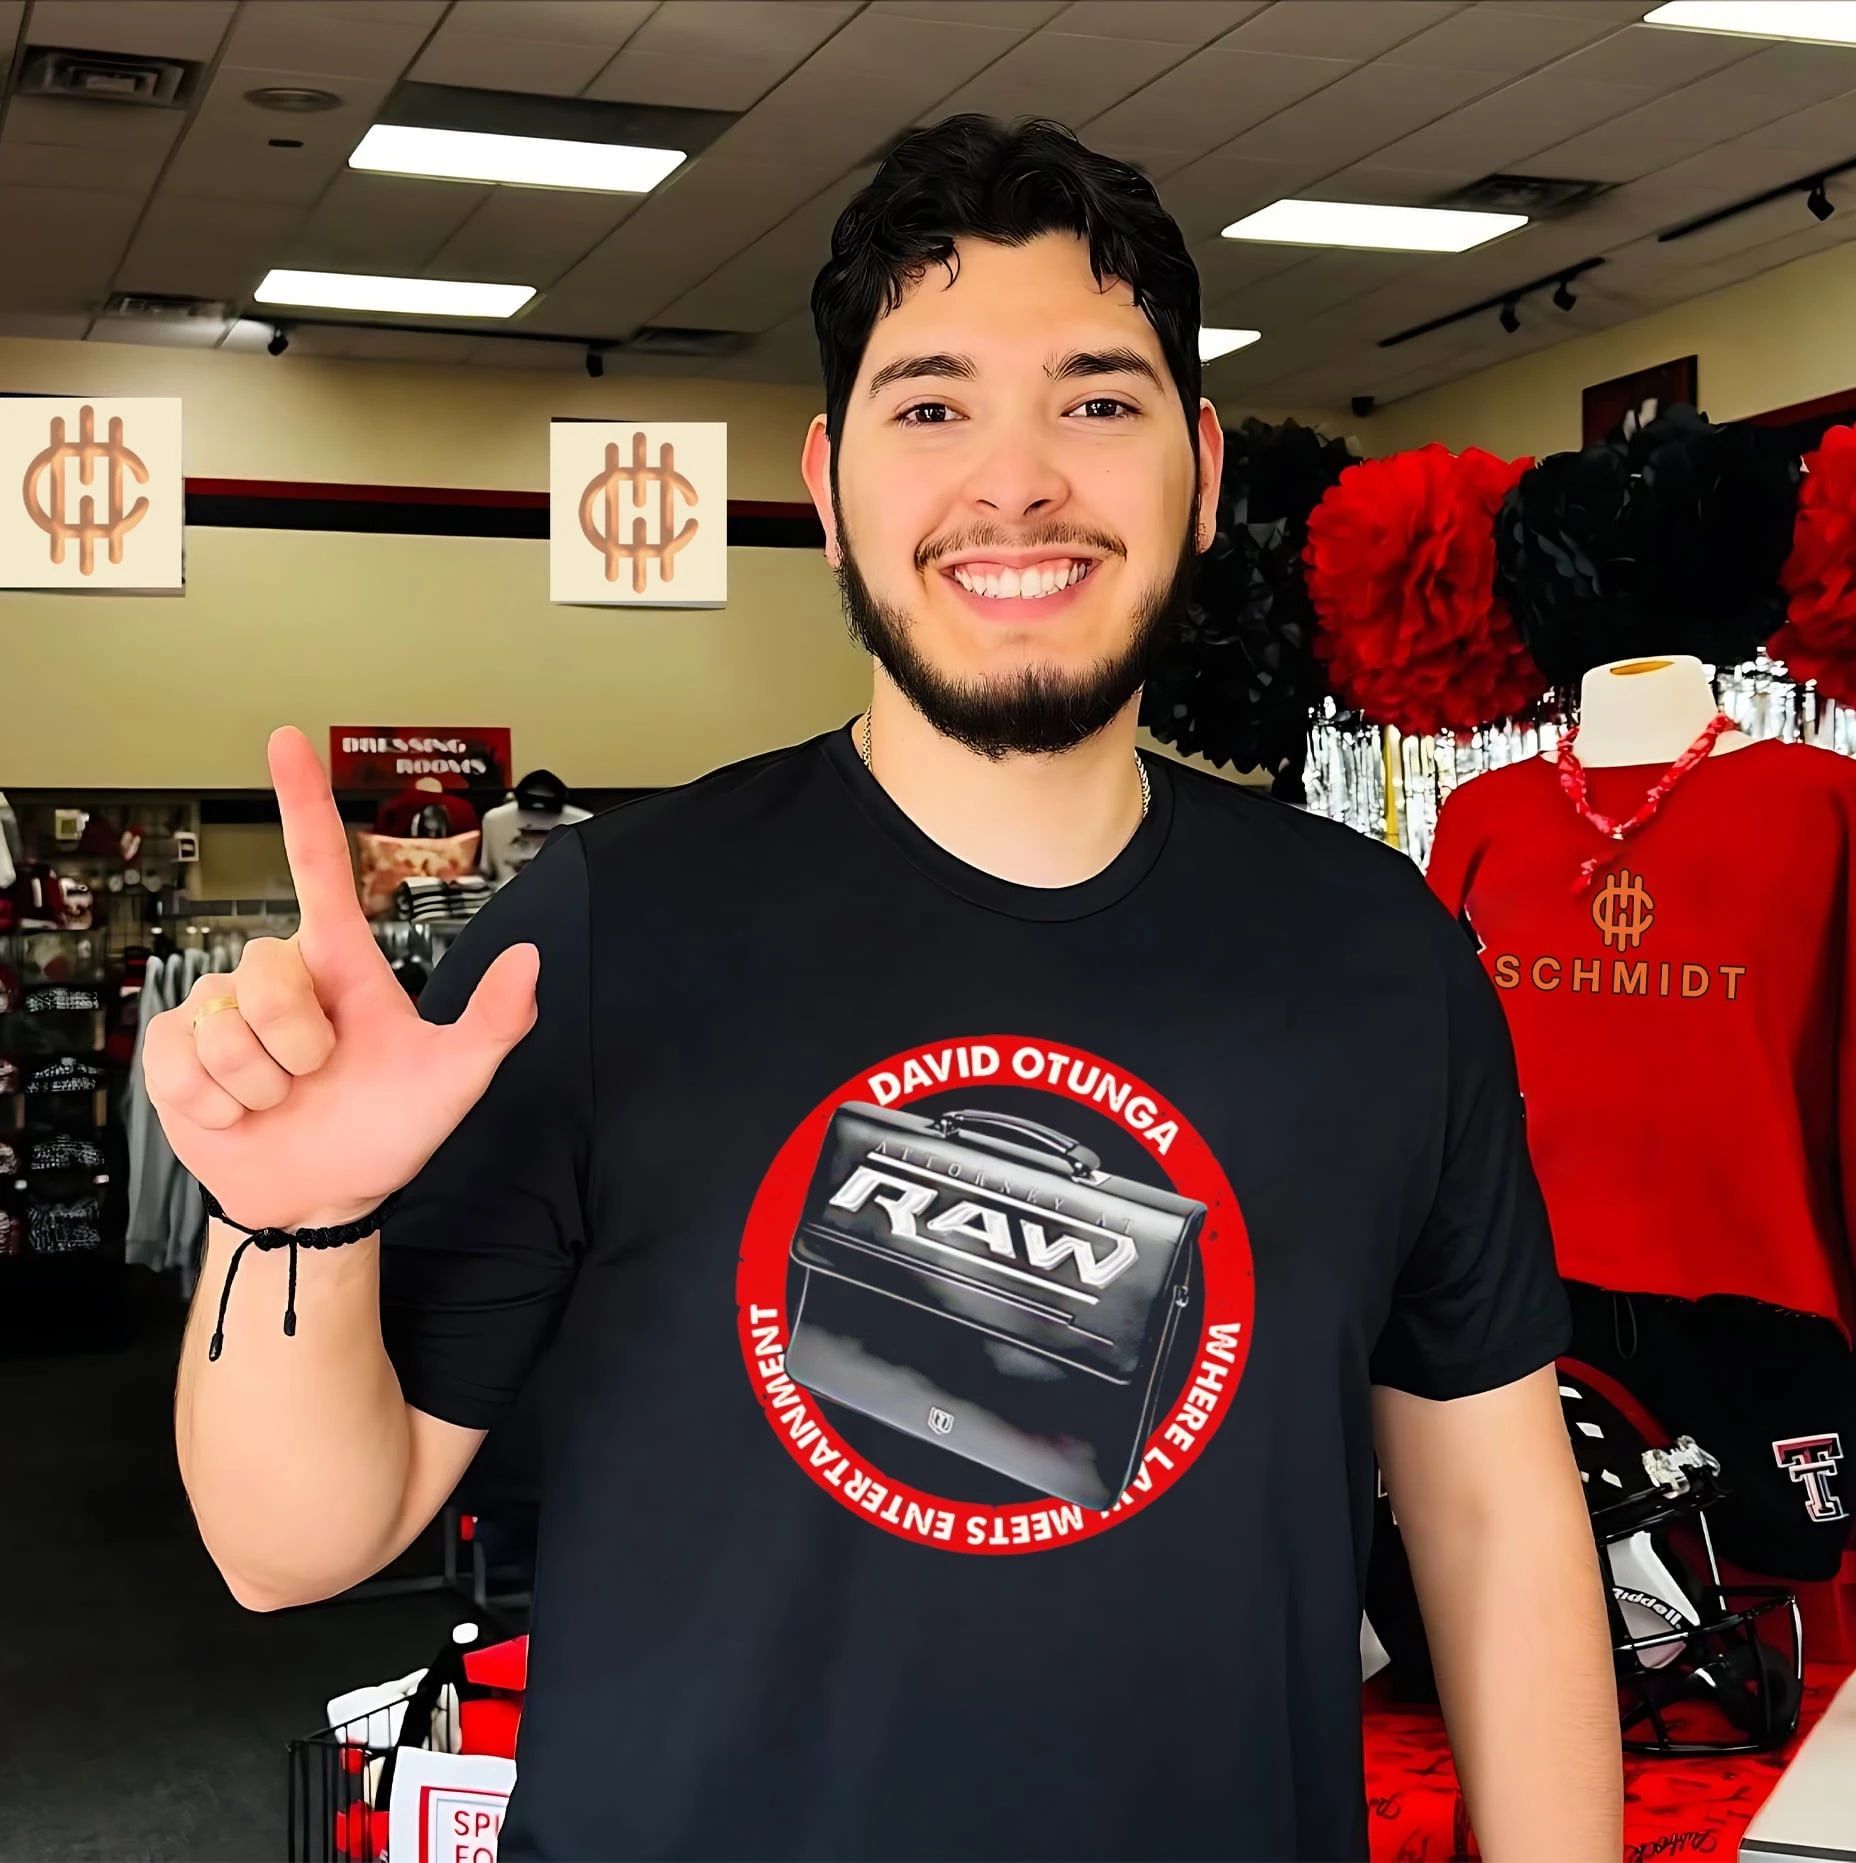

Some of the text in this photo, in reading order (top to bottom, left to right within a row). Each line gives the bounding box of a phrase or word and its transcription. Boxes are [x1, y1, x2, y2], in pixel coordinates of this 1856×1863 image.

[342, 737, 467, 754] DRESSING
[396, 758, 487, 775] ROOMS
[1494, 954, 1746, 1000] SCHMIDT
[867, 1045, 1179, 1155] DAVID OTUNGA
[829, 1164, 1140, 1287] RAW
[875, 1140, 1135, 1235] ATTORNEY AT
[749, 1304, 956, 1541] ENTERTAINMENT
[1164, 1322, 1241, 1453] WHERE
[966, 1504, 1085, 1546] MEETS
